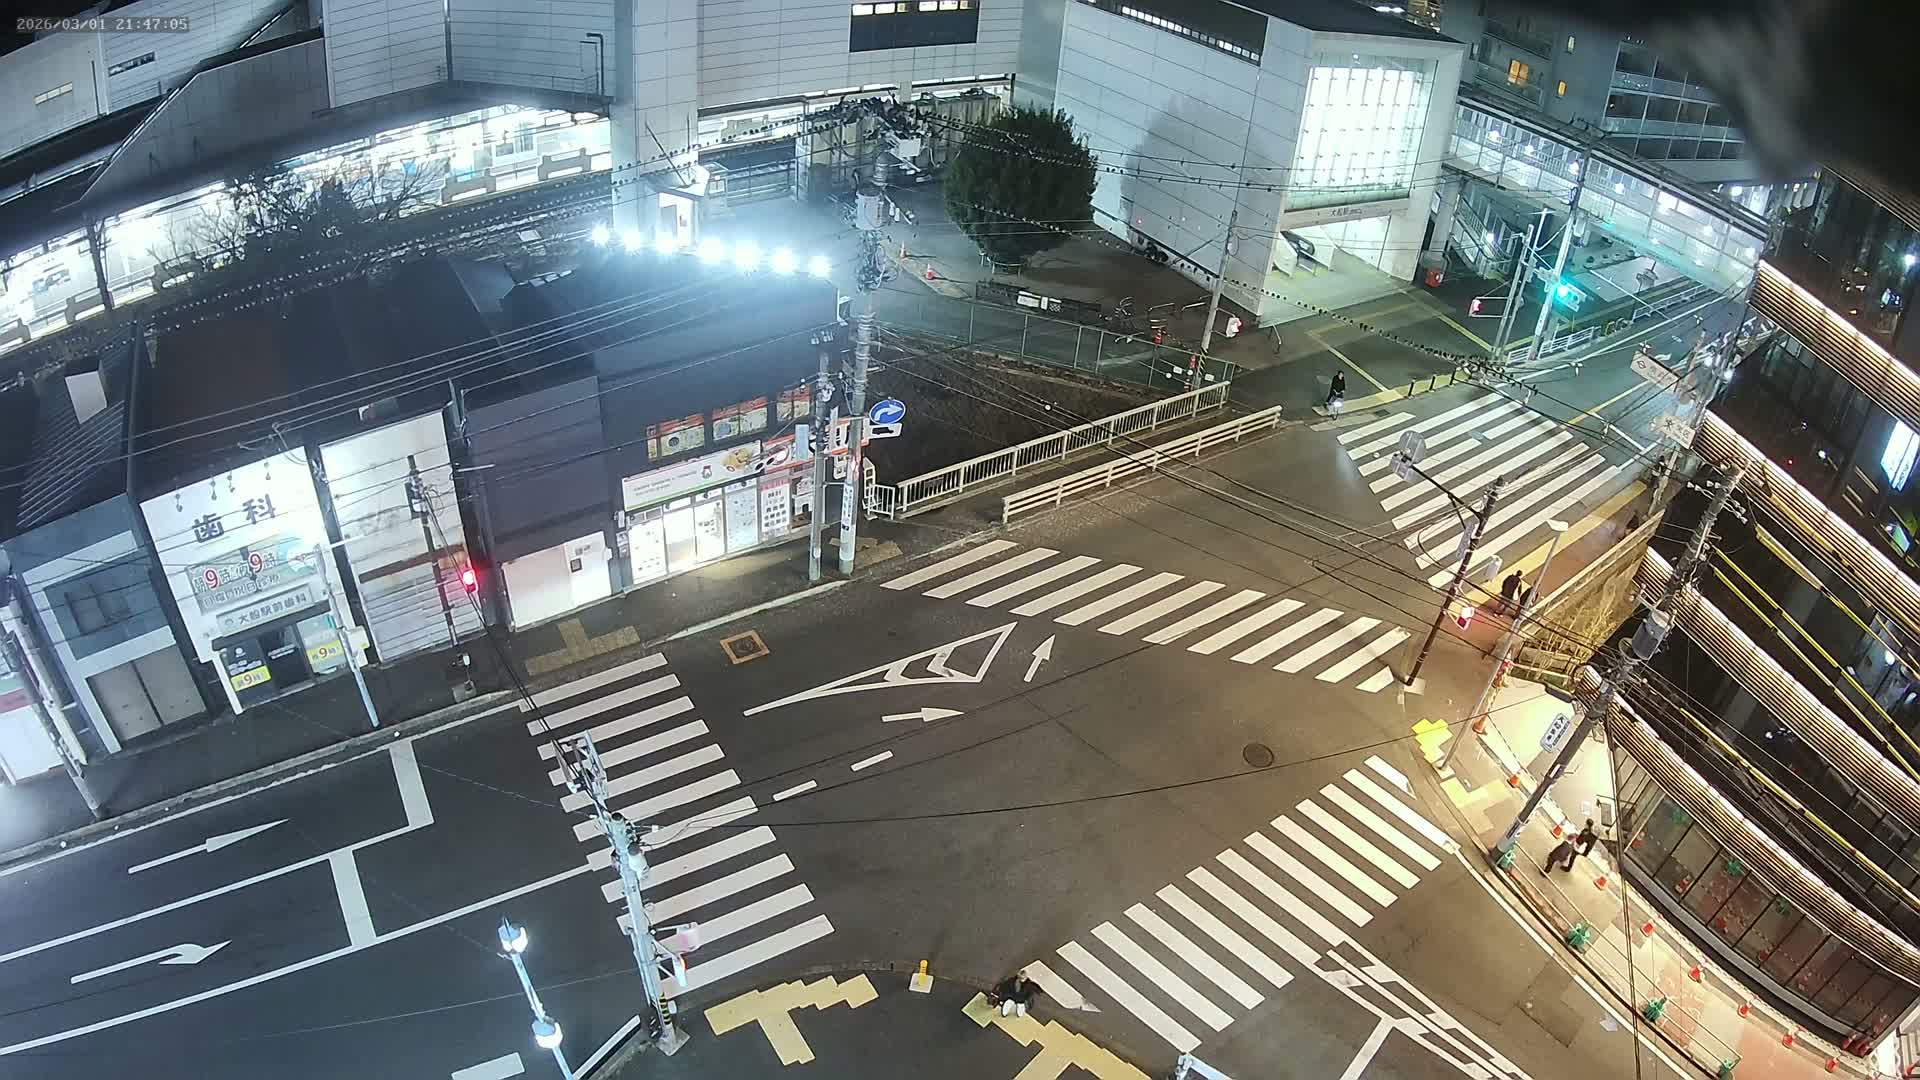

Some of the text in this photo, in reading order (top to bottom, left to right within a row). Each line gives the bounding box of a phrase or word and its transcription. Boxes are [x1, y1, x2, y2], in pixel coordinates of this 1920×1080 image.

[192, 494, 275, 543] 歯科
[239, 593, 307, 624] 大船駅前歯科
